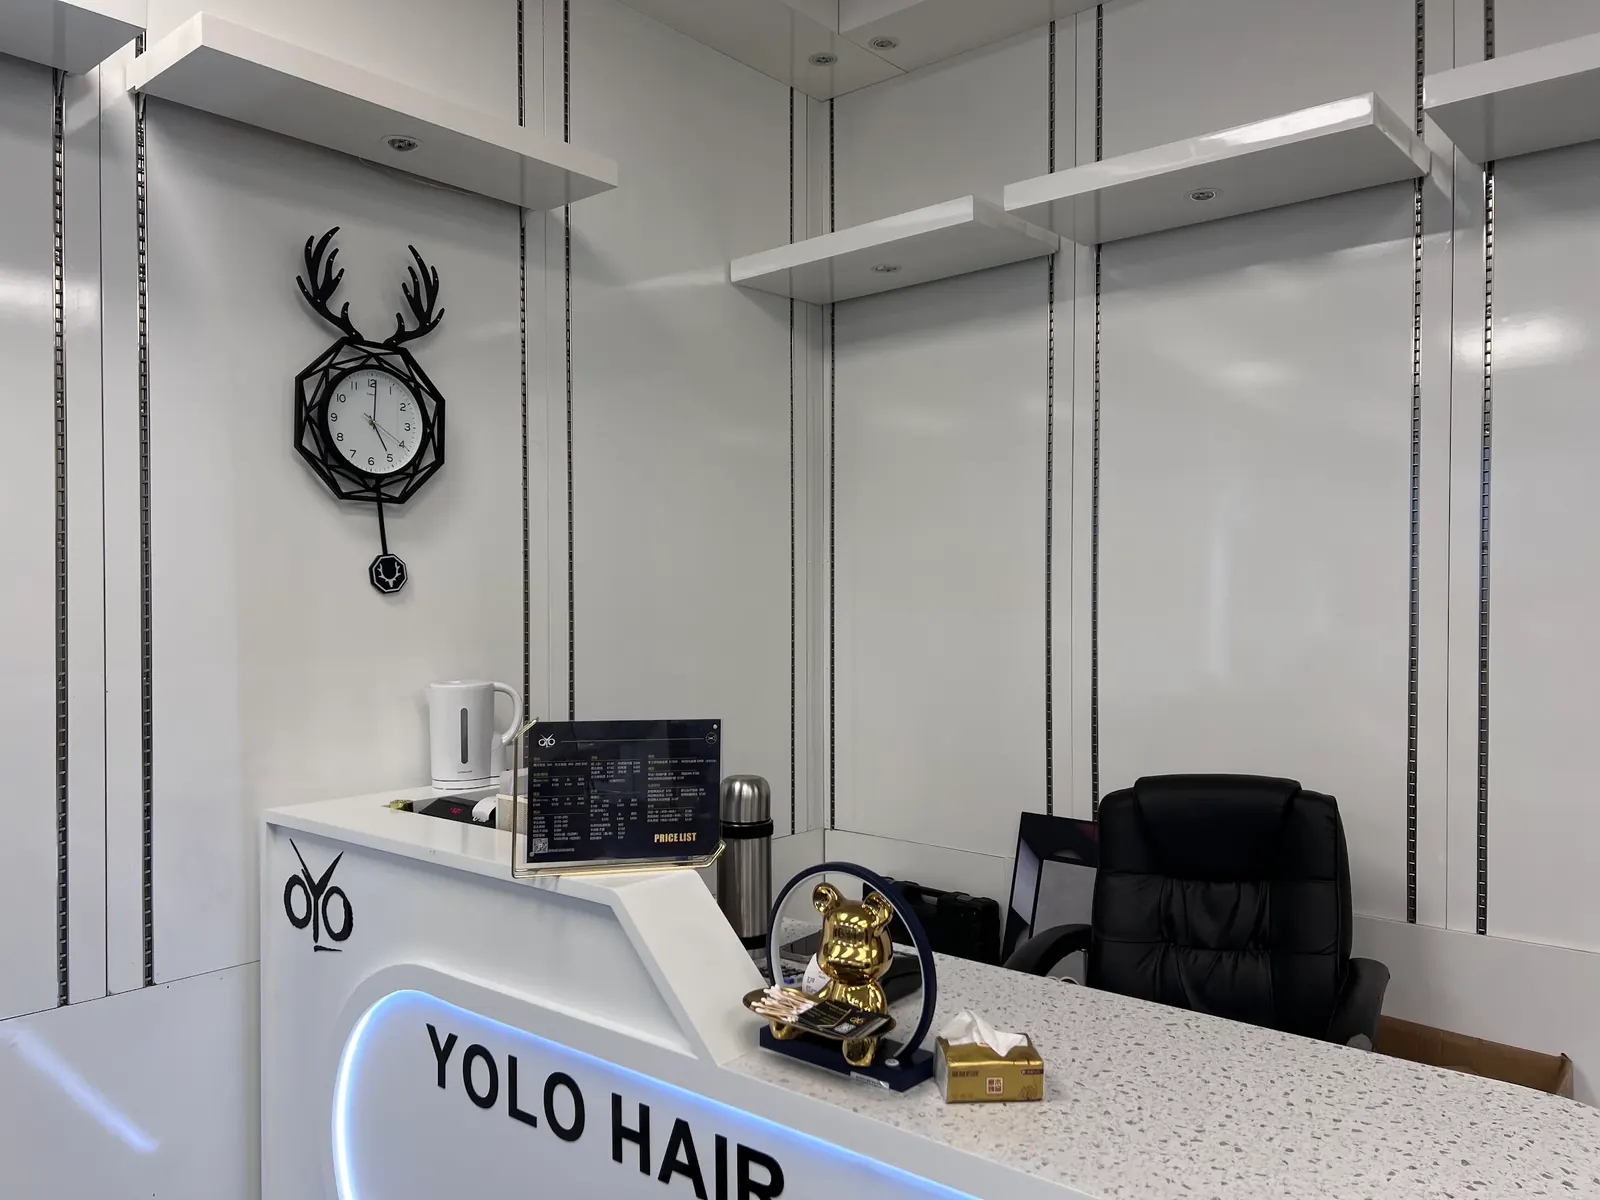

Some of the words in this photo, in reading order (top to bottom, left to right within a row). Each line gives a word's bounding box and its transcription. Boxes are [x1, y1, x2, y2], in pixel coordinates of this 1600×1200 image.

[351, 381, 358, 390] 11
[336, 393, 346, 403] 10
[399, 403, 406, 411] 2
[331, 413, 337, 422] 9
[404, 423, 410, 431] 3
[336, 433, 344, 441] 8
[398, 440, 405, 448] 4
[350, 449, 356, 458] 7
[368, 457, 375, 465] 6
[387, 454, 393, 462] 5
[653, 832, 679, 843] PRICE
[679, 832, 697, 842] LIST
[426, 1023, 586, 1142] YOLO
[610, 1092, 785, 1200] HAIR
